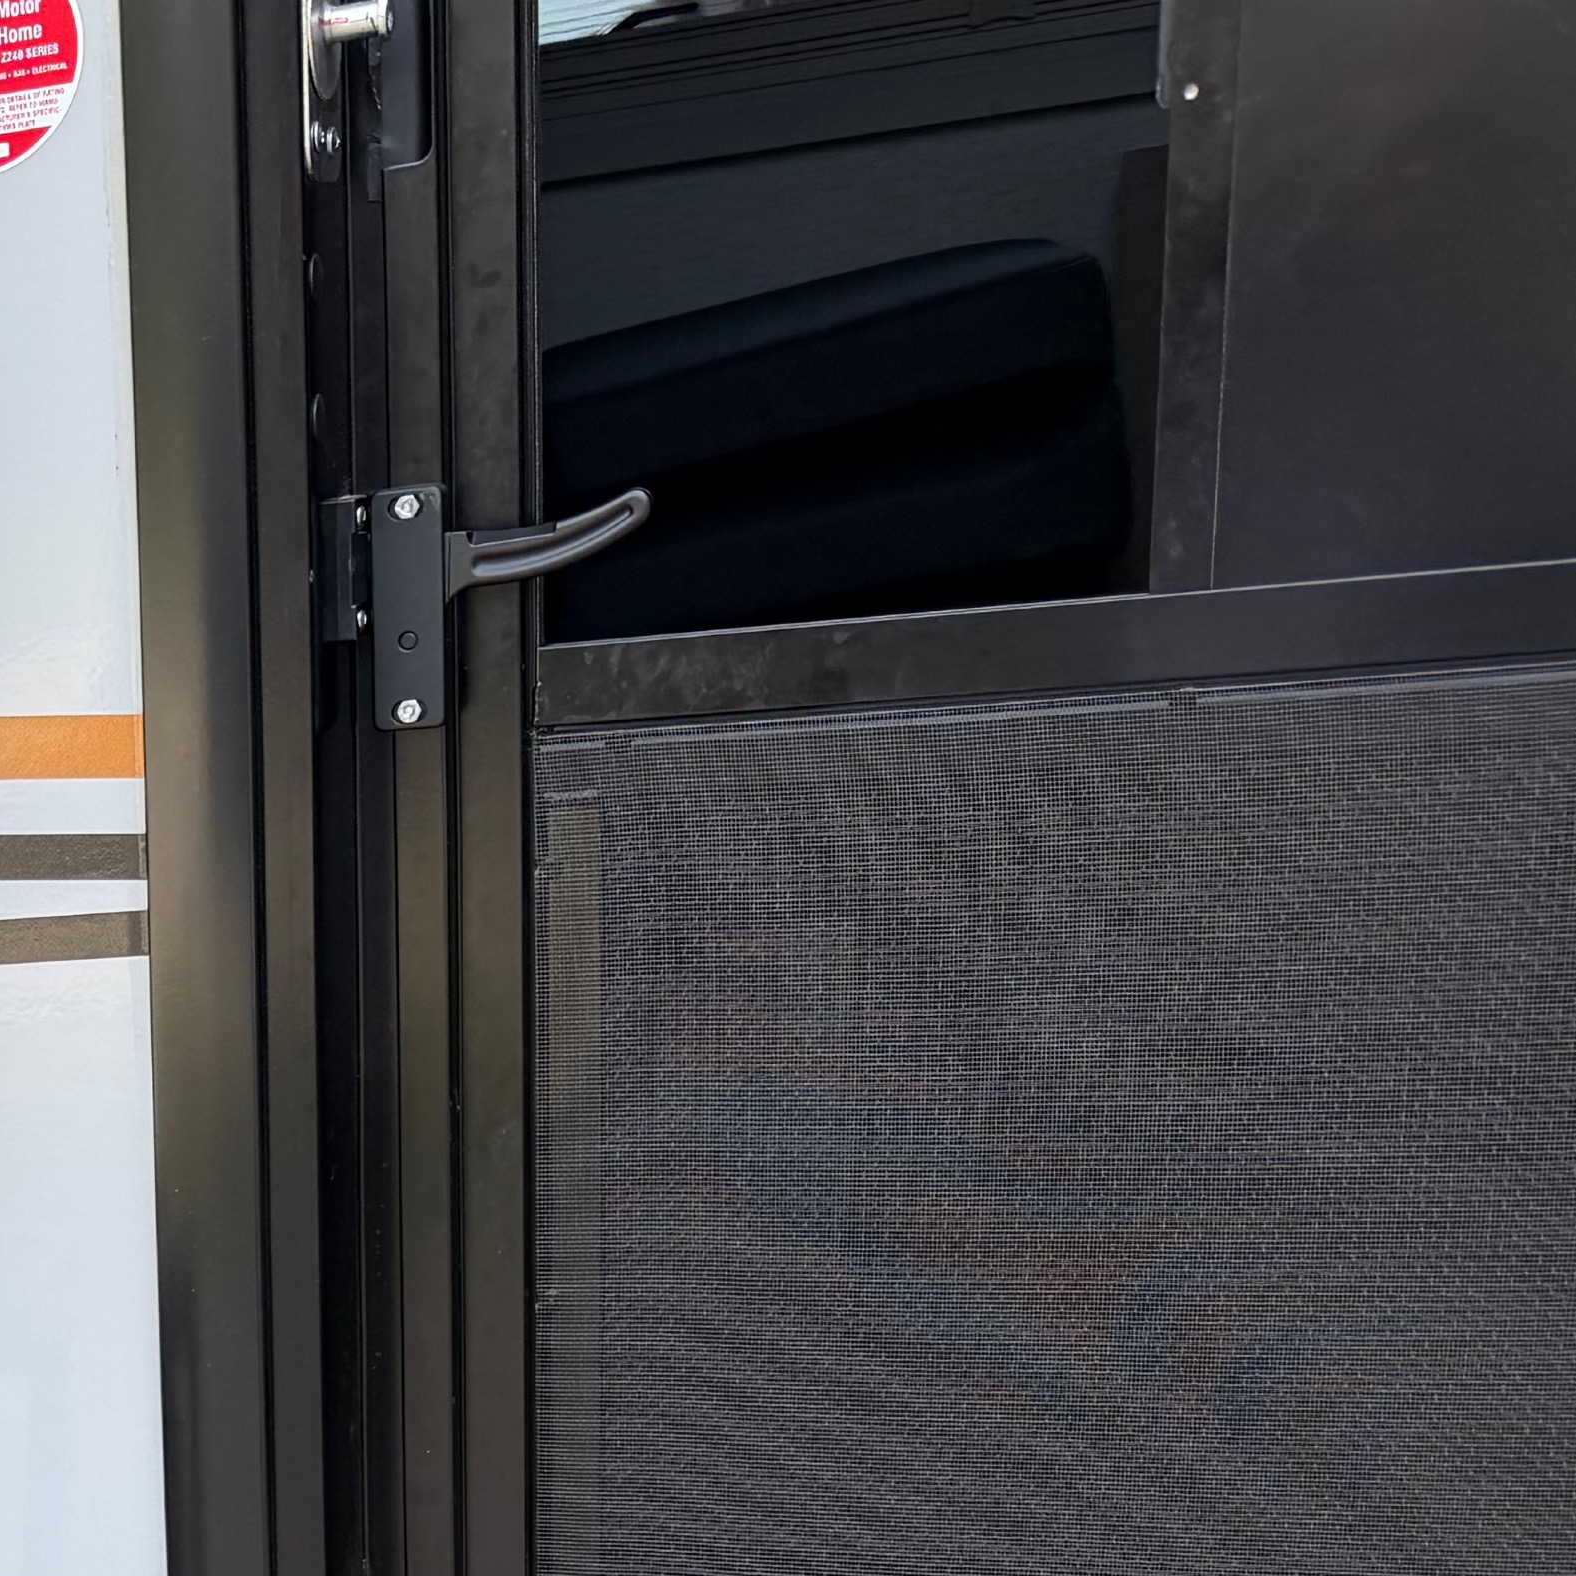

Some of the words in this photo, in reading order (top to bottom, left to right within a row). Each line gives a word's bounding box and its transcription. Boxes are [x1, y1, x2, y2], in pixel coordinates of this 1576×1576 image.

[1, 48, 24, 63] Z240
[26, 42, 59, 59] SERIES
[32, 62, 68, 75] ELECTRICAL
